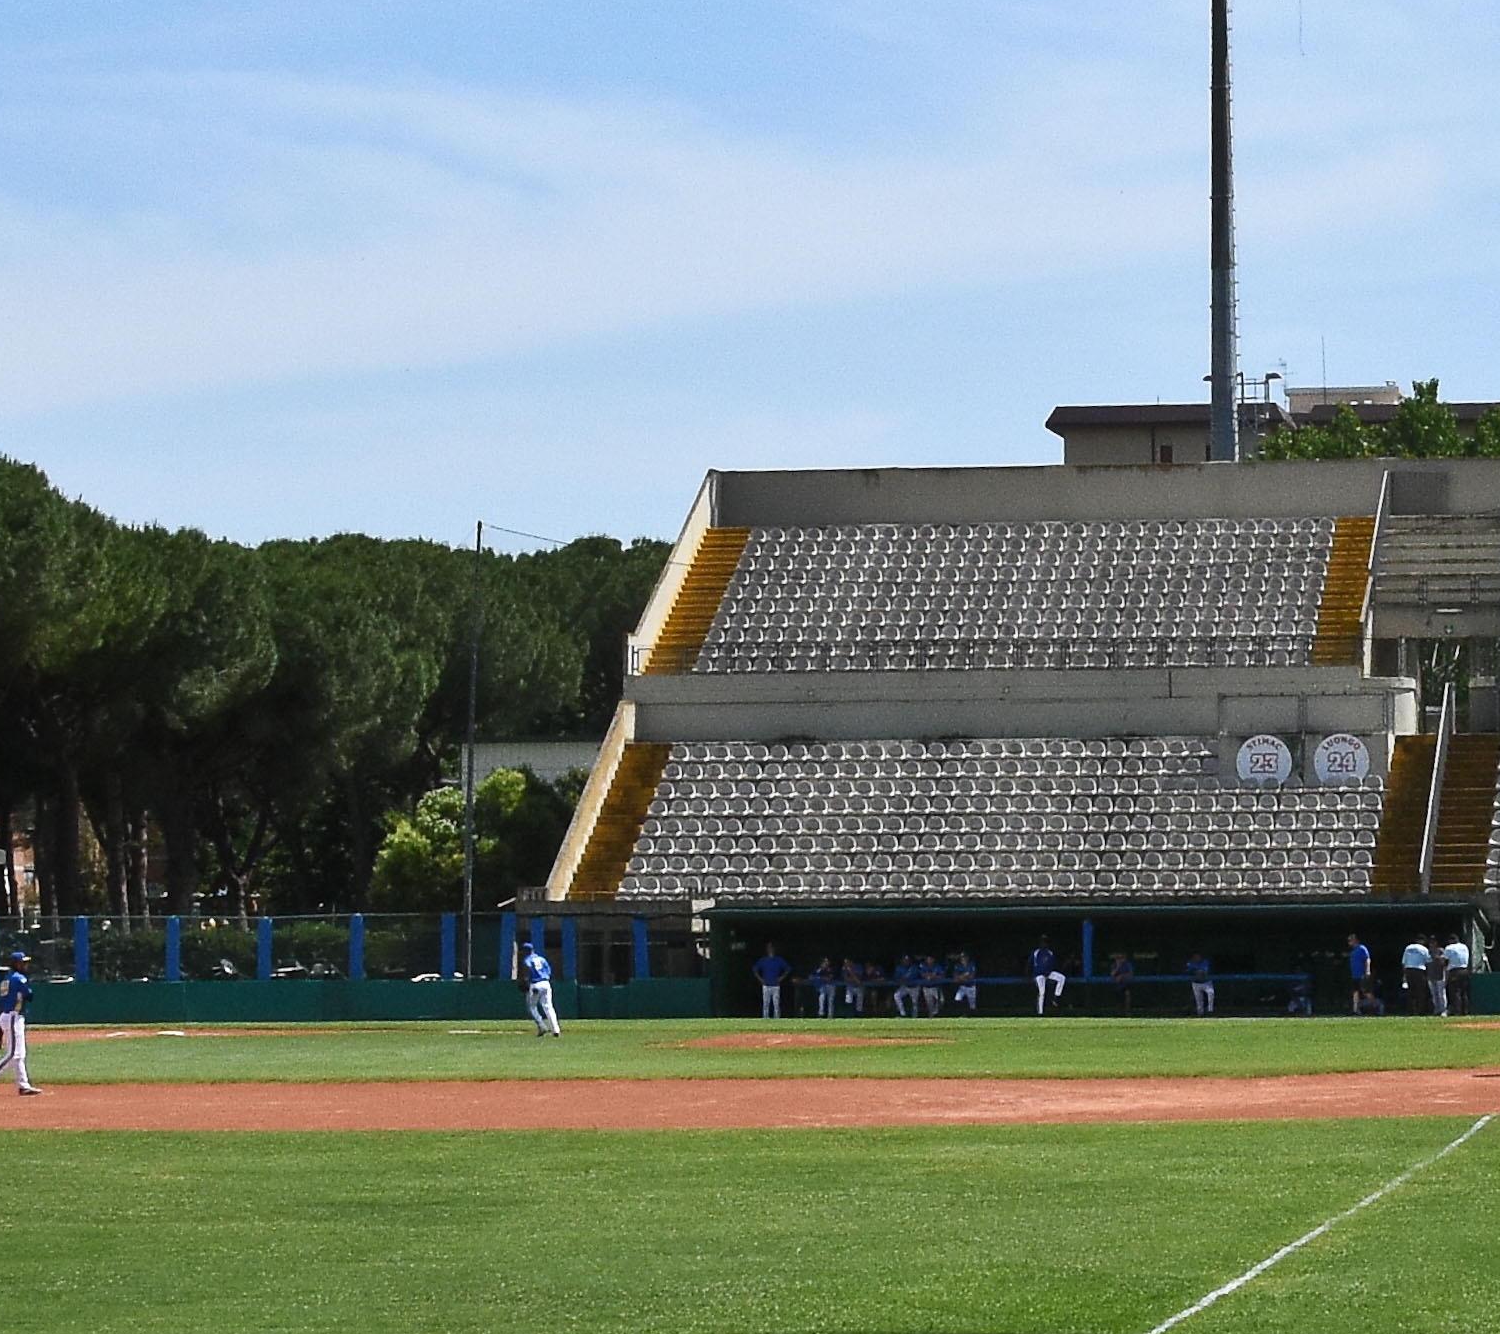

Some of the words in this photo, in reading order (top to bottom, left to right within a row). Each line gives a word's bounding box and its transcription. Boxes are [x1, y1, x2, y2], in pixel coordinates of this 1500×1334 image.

[1246, 738, 1283, 750] STIMAC
[1322, 736, 1361, 751] LUONGO
[1250, 753, 1279, 773] 23
[1327, 751, 1357, 772] 24
